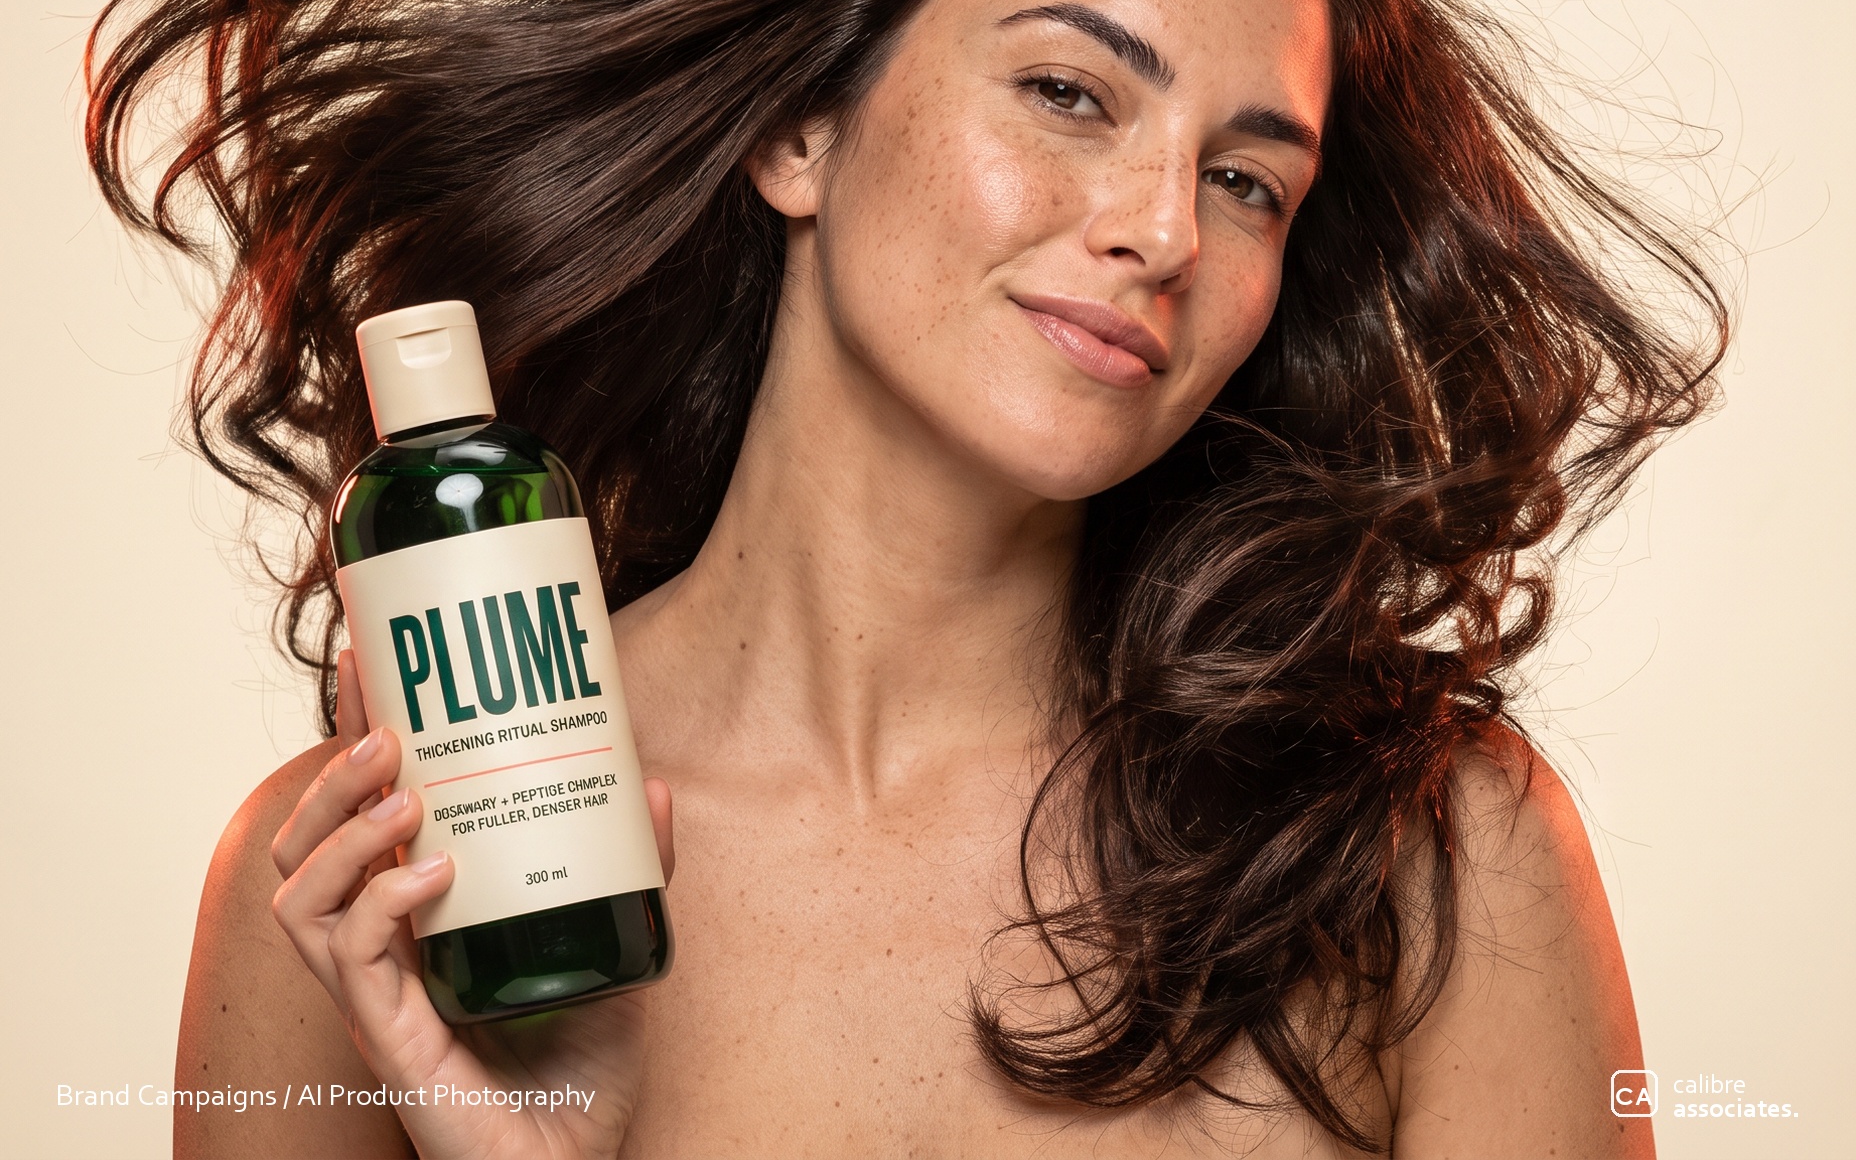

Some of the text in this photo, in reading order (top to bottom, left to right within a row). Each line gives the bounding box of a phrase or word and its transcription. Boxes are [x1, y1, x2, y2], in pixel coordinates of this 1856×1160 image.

[389, 581, 602, 734] PLUME
[415, 710, 608, 762] THICKENING RITUAL SHAMPOO
[451, 792, 609, 836] FOR FULLER, DENSER HAIR
[525, 867, 568, 886] 300 ml
